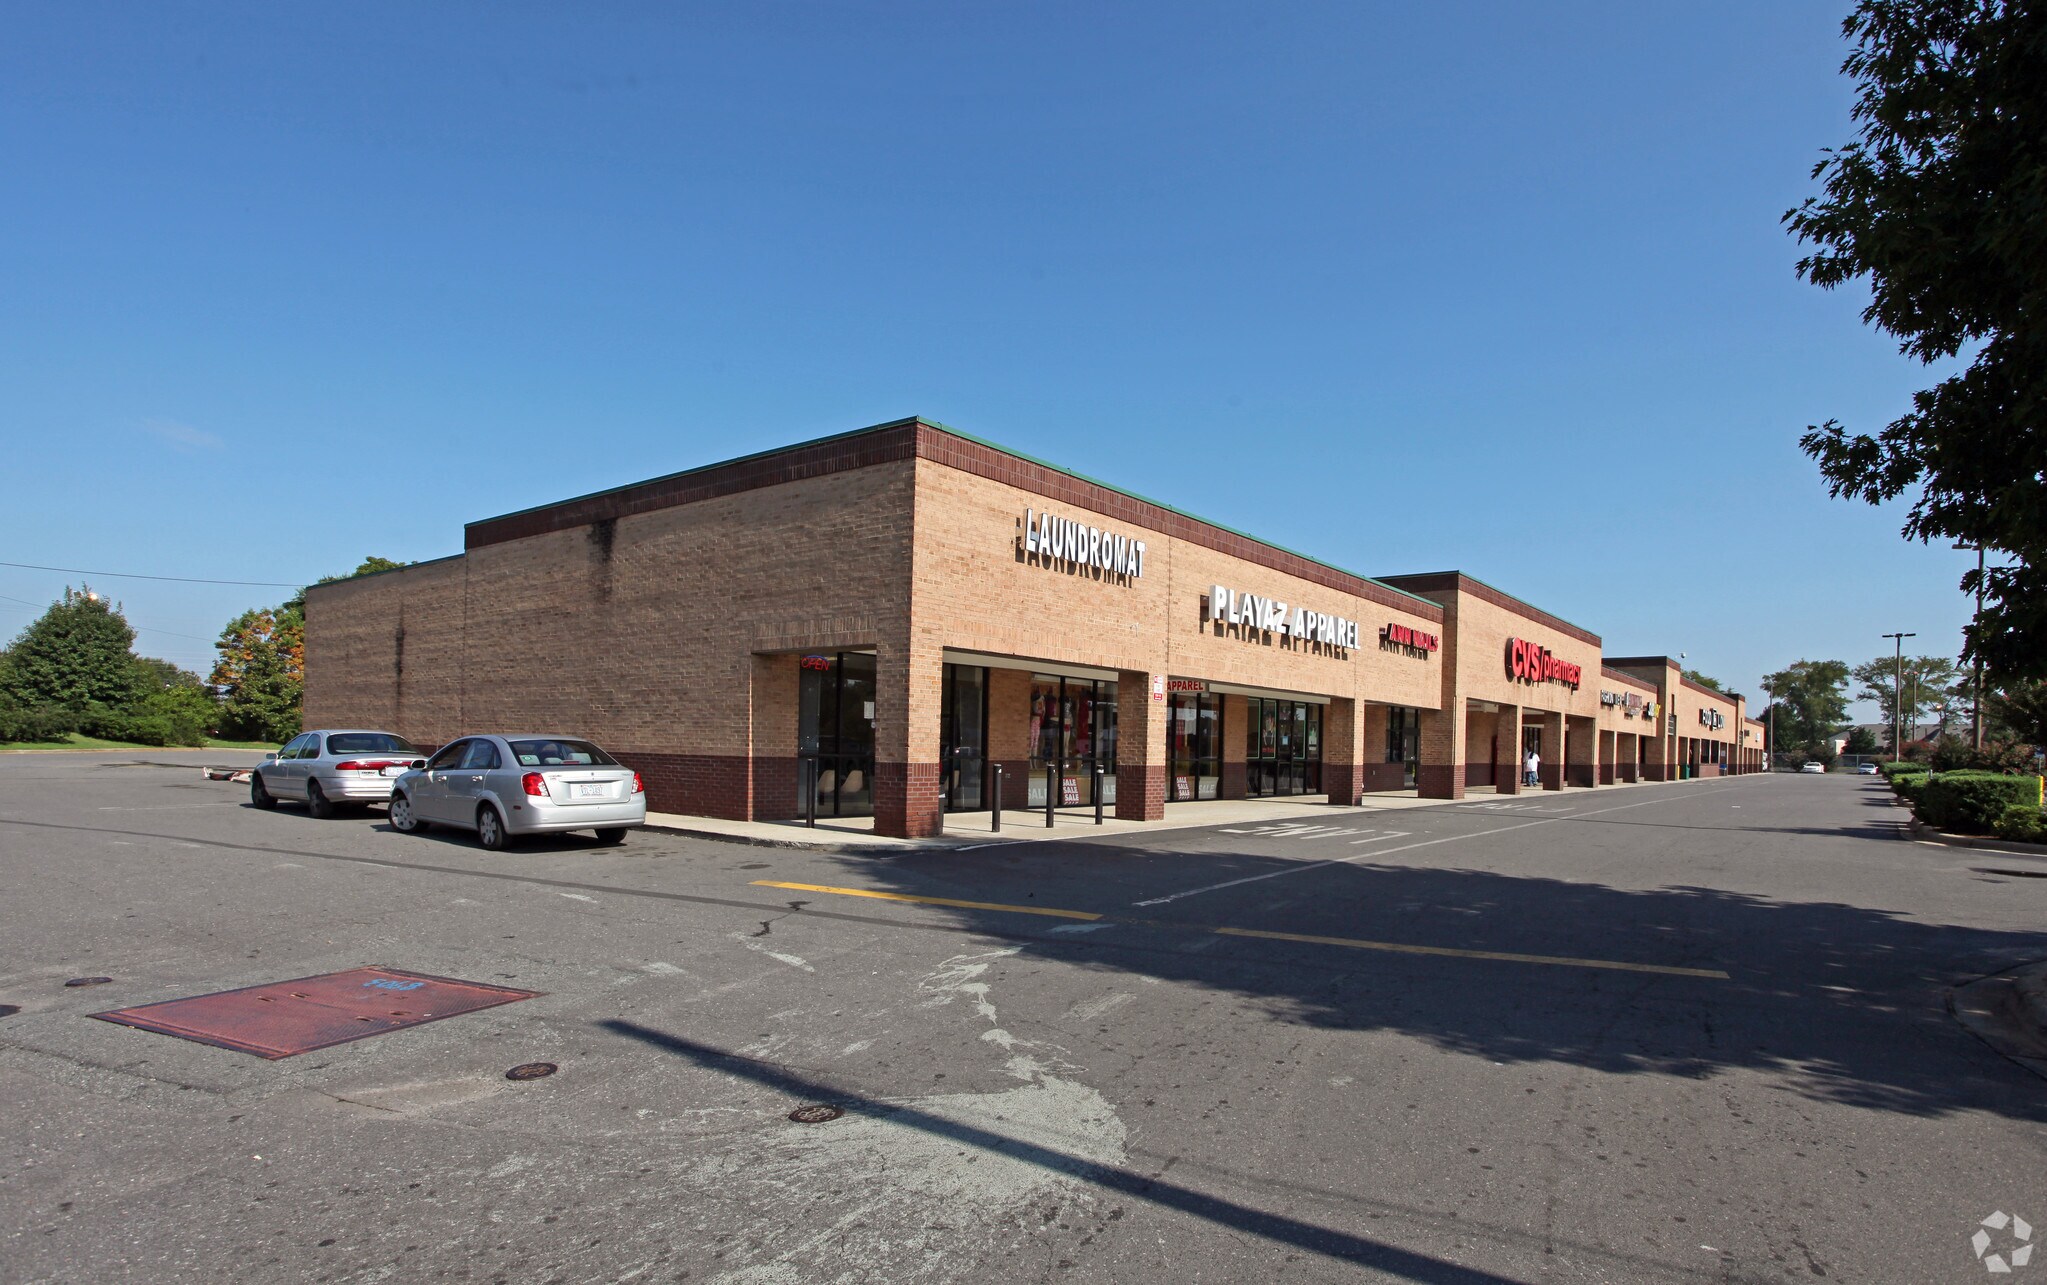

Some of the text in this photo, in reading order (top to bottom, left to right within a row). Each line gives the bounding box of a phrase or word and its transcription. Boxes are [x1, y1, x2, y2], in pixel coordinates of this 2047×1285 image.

[1025, 508, 1146, 578] LAUNDROMAT
[1210, 585, 1361, 650] PLAYAZ APPAREL
[1390, 623, 1439, 652] ANN NAILS
[801, 657, 830, 671] OPEN
[1166, 680, 1204, 691] APPAREL
[1062, 778, 1077, 787] SALE
[1063, 786, 1078, 794] SALE
[1199, 784, 1215, 794] SALE
[1065, 793, 1080, 801] SALE
